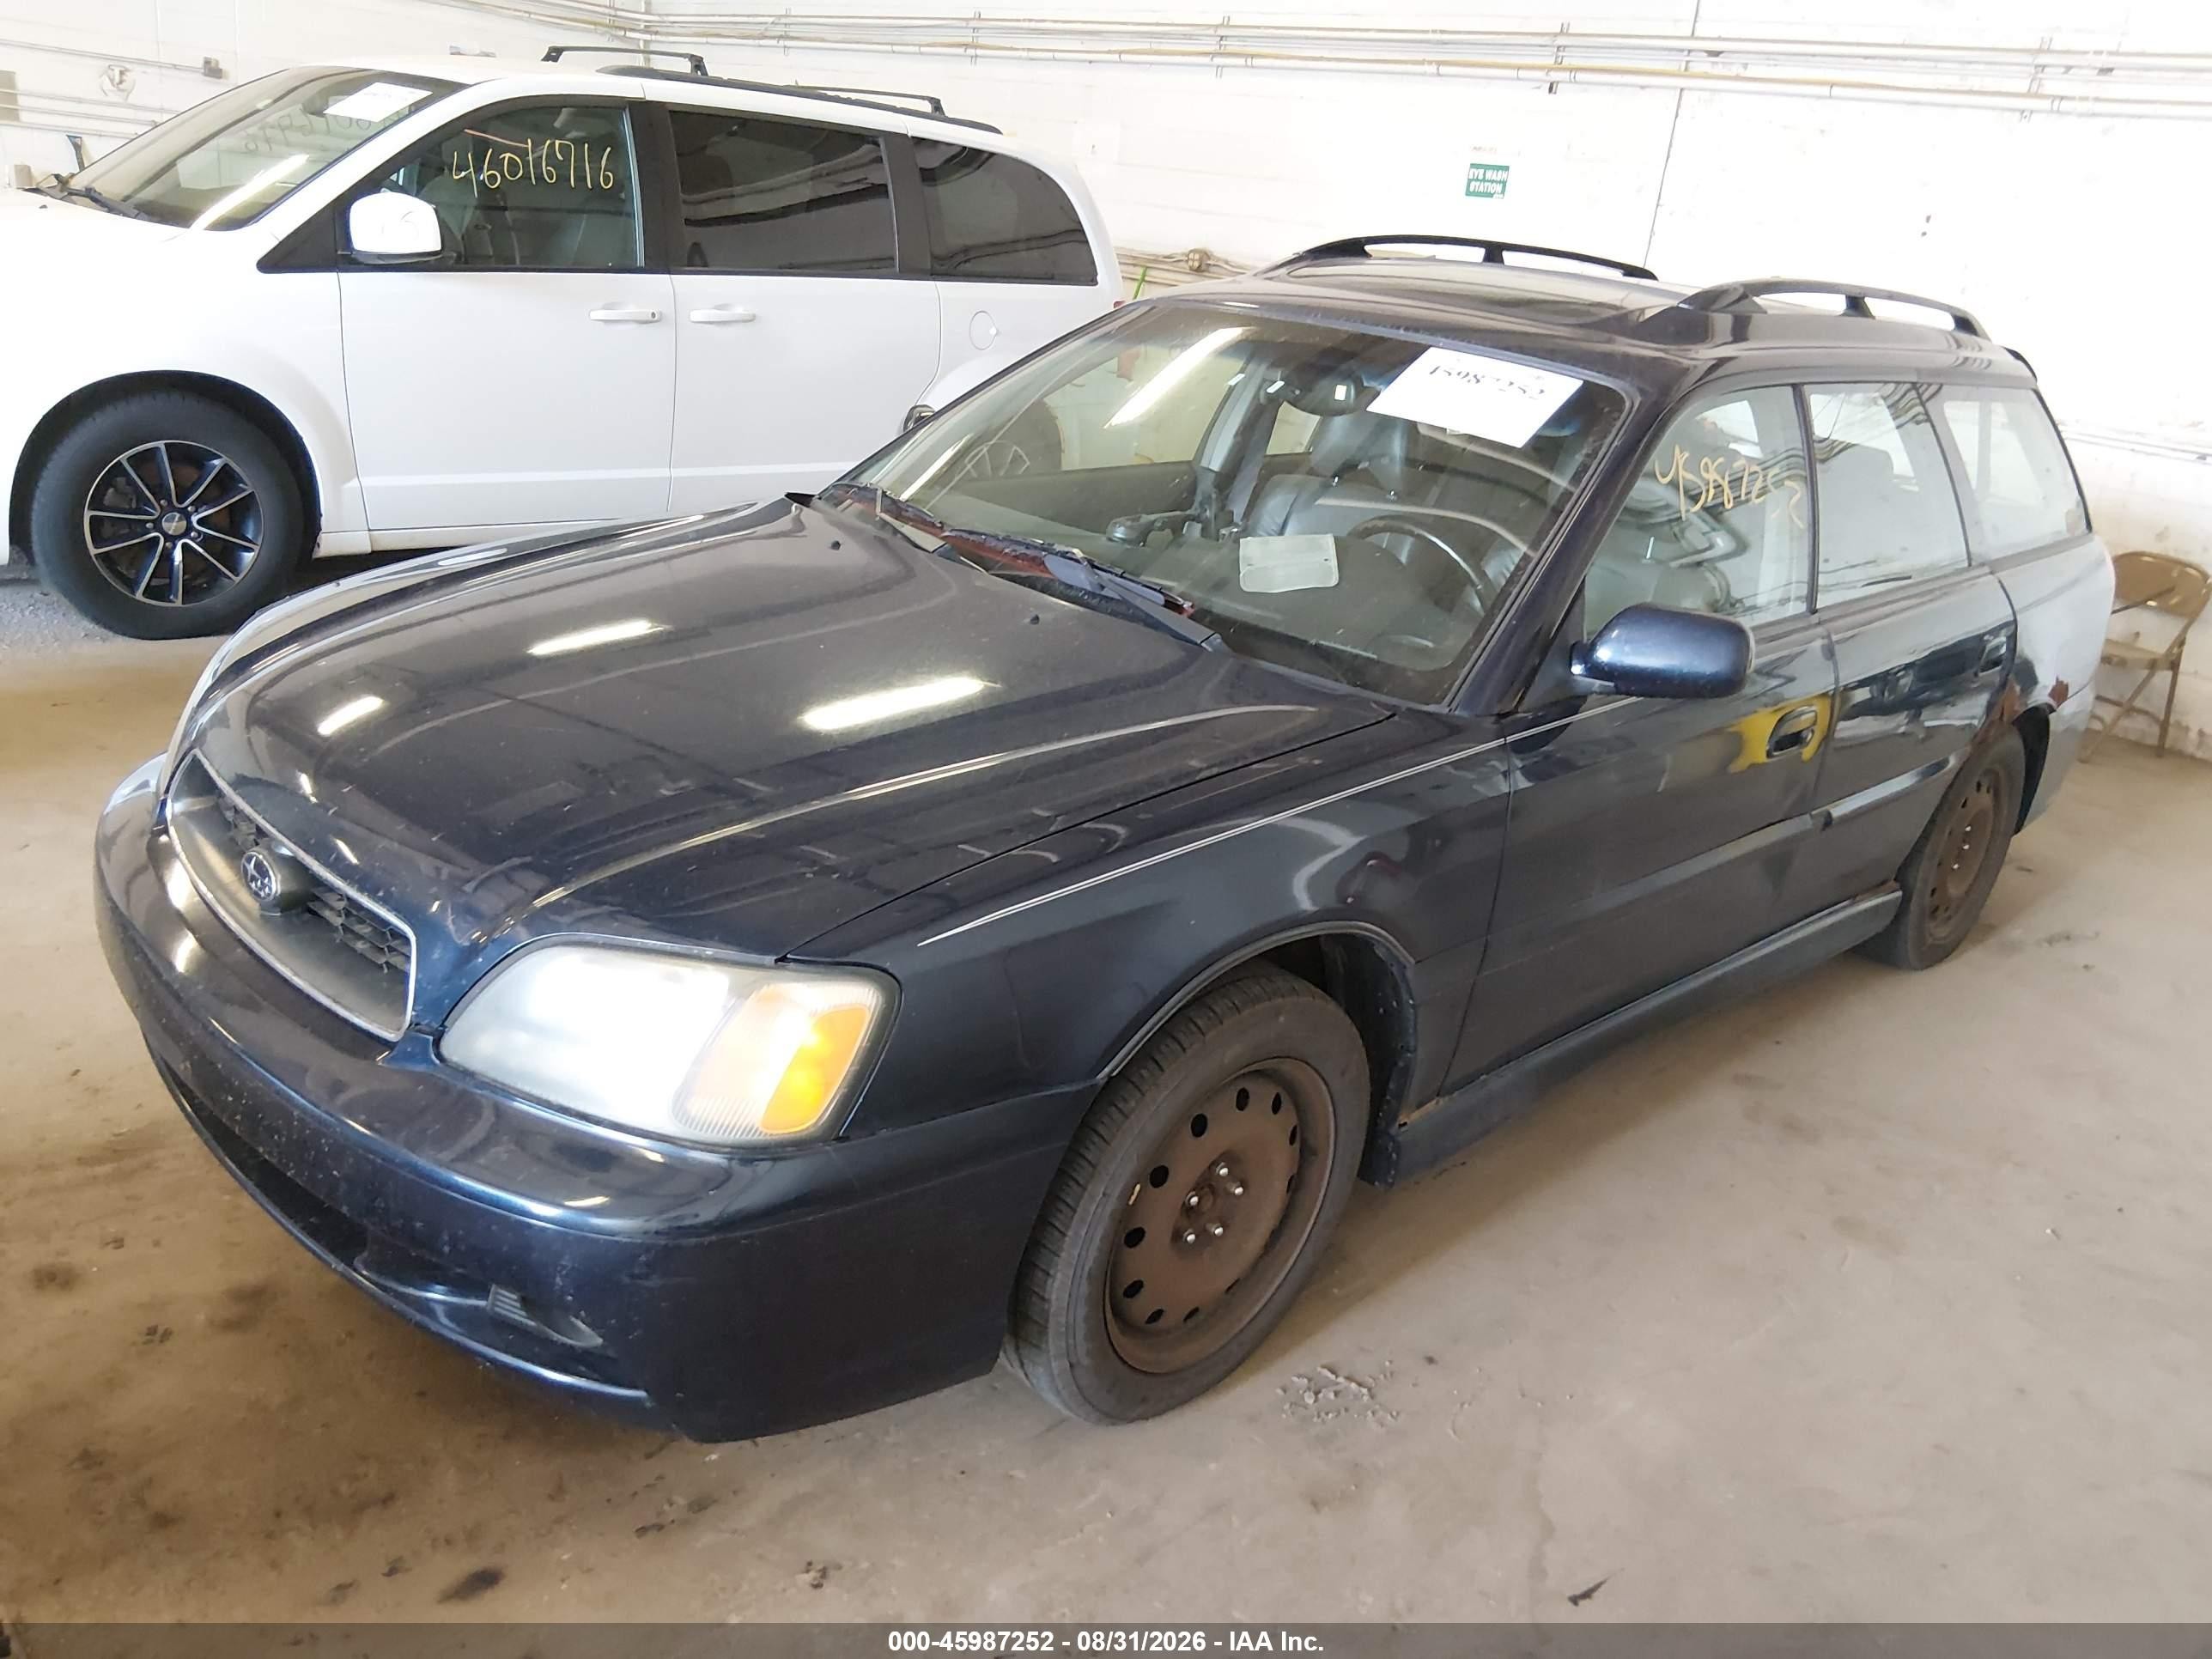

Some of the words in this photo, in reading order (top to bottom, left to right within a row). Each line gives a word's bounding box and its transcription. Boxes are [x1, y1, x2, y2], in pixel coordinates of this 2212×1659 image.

[453, 138, 614, 198] 46016716
[1485, 169, 1509, 183] WASH
[1469, 180, 1504, 194] STATION
